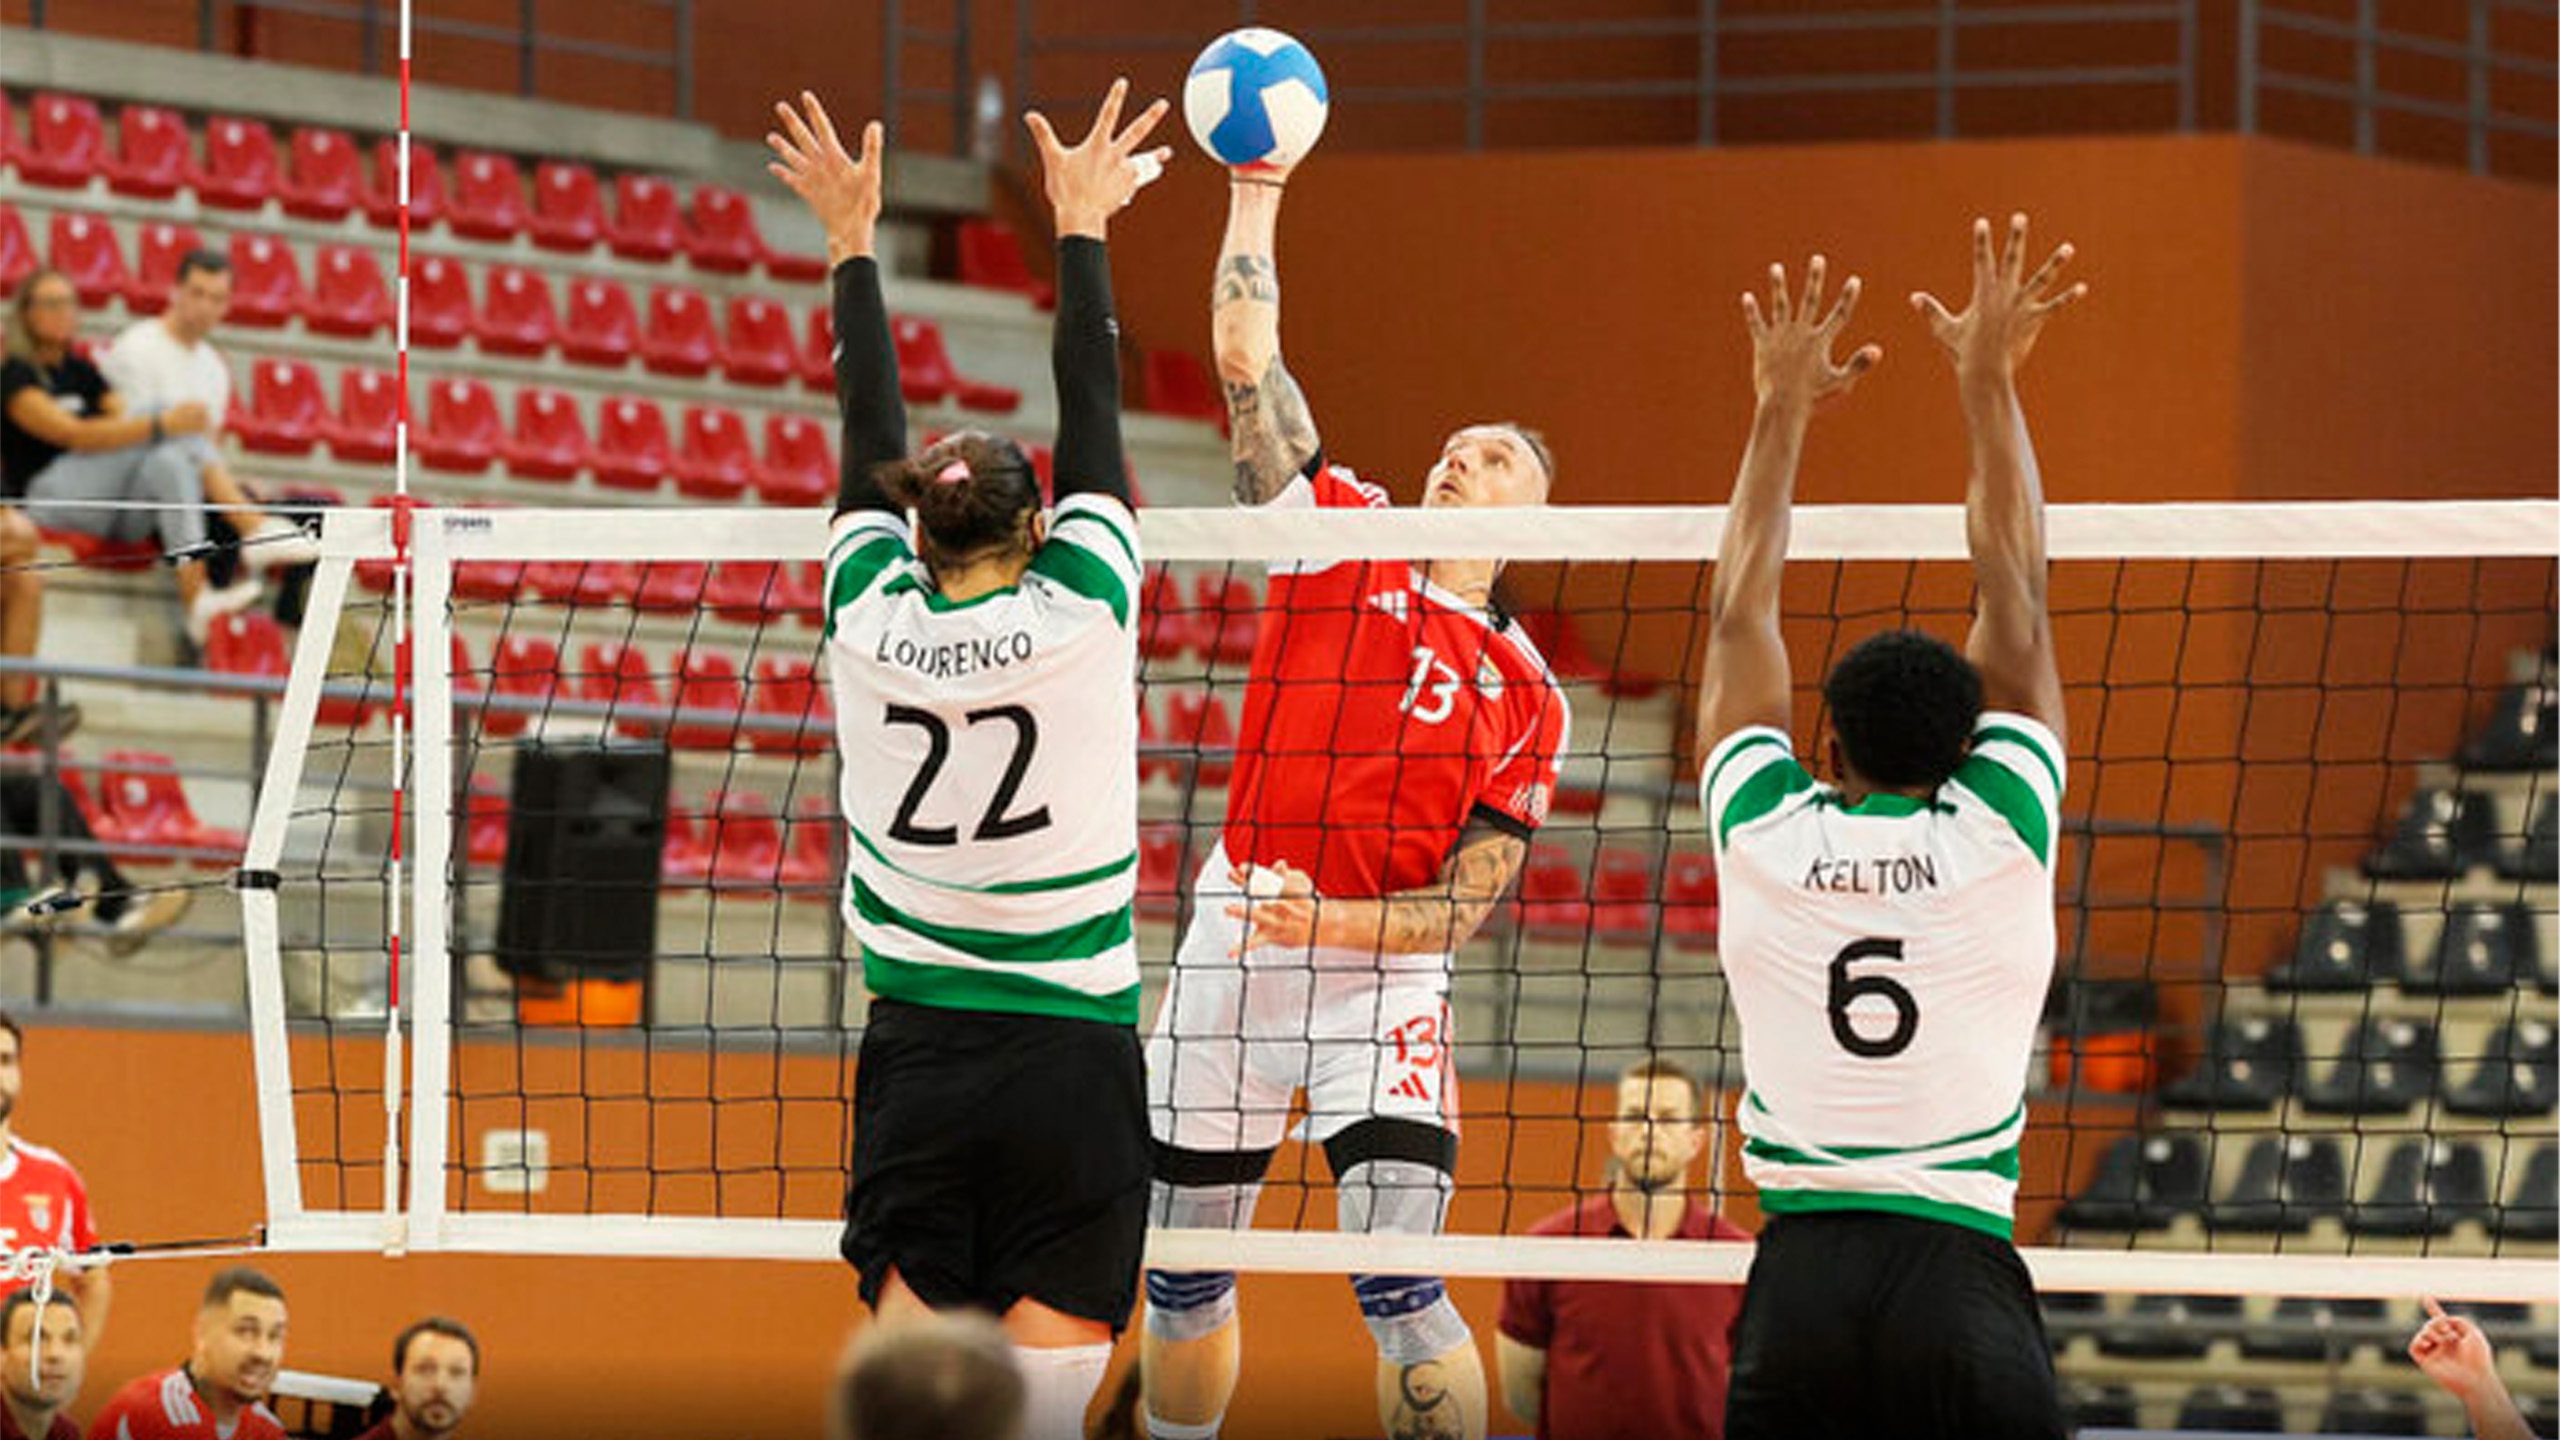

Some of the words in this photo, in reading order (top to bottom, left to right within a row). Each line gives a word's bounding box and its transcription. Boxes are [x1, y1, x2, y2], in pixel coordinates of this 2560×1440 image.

[1398, 646, 1462, 724] 13
[884, 702, 1052, 846] 22
[1804, 854, 1937, 894] KELTON
[1827, 937, 1919, 1058] 6
[1385, 1015, 1436, 1068] 13
